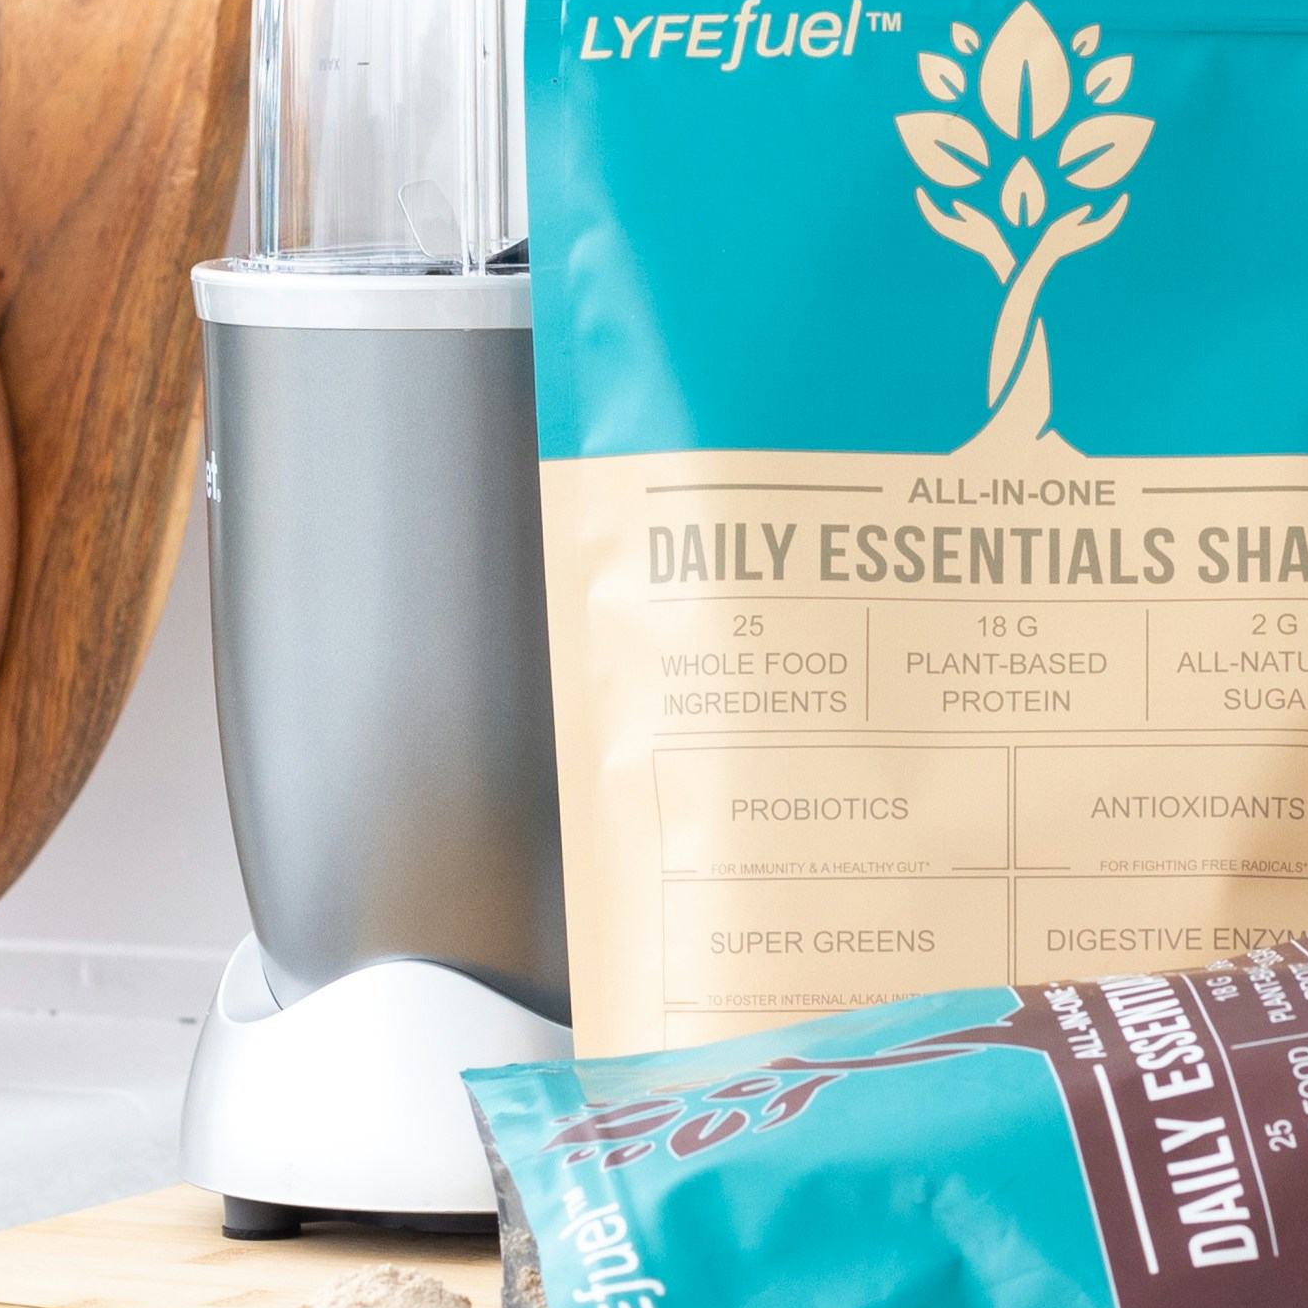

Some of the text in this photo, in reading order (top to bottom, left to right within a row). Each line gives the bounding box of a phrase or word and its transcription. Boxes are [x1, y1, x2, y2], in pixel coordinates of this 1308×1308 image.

[908, 477, 1117, 508] ALL-IN-ONE
[648, 523, 797, 585] DAILY
[819, 524, 1176, 585] ESSENTIALS
[732, 614, 765, 638] 25
[976, 616, 1039, 639] 18 G
[1252, 613, 1299, 636] 2 G
[662, 652, 848, 677] WHOLE FOOD
[906, 652, 1108, 675] PLANT-BASED
[664, 690, 848, 715] INGREDIENTS
[942, 690, 1071, 713] PROTEIN
[731, 797, 909, 822] PROBIOTICS
[1092, 795, 1307, 821] ANTIOXIDANTS
[712, 864, 736, 875] FOR
[740, 863, 805, 875] IMMUNITY
[809, 863, 817, 873] &
[821, 863, 831, 873] A
[833, 862, 894, 873] HEALTHY
[1101, 861, 1129, 871] FOR
[1133, 860, 1197, 871] FIGHTING
[1202, 860, 1236, 870] FREE
[710, 929, 936, 955] SUPER GREENS
[1048, 928, 1202, 951] DIGESTIVE
[707, 995, 722, 1006] TO
[725, 995, 776, 1006] FOSTER
[781, 994, 843, 1005] INTERNAL
[1263, 1118, 1297, 1151] 25
[1154, 1115, 1259, 1268] DAILY
